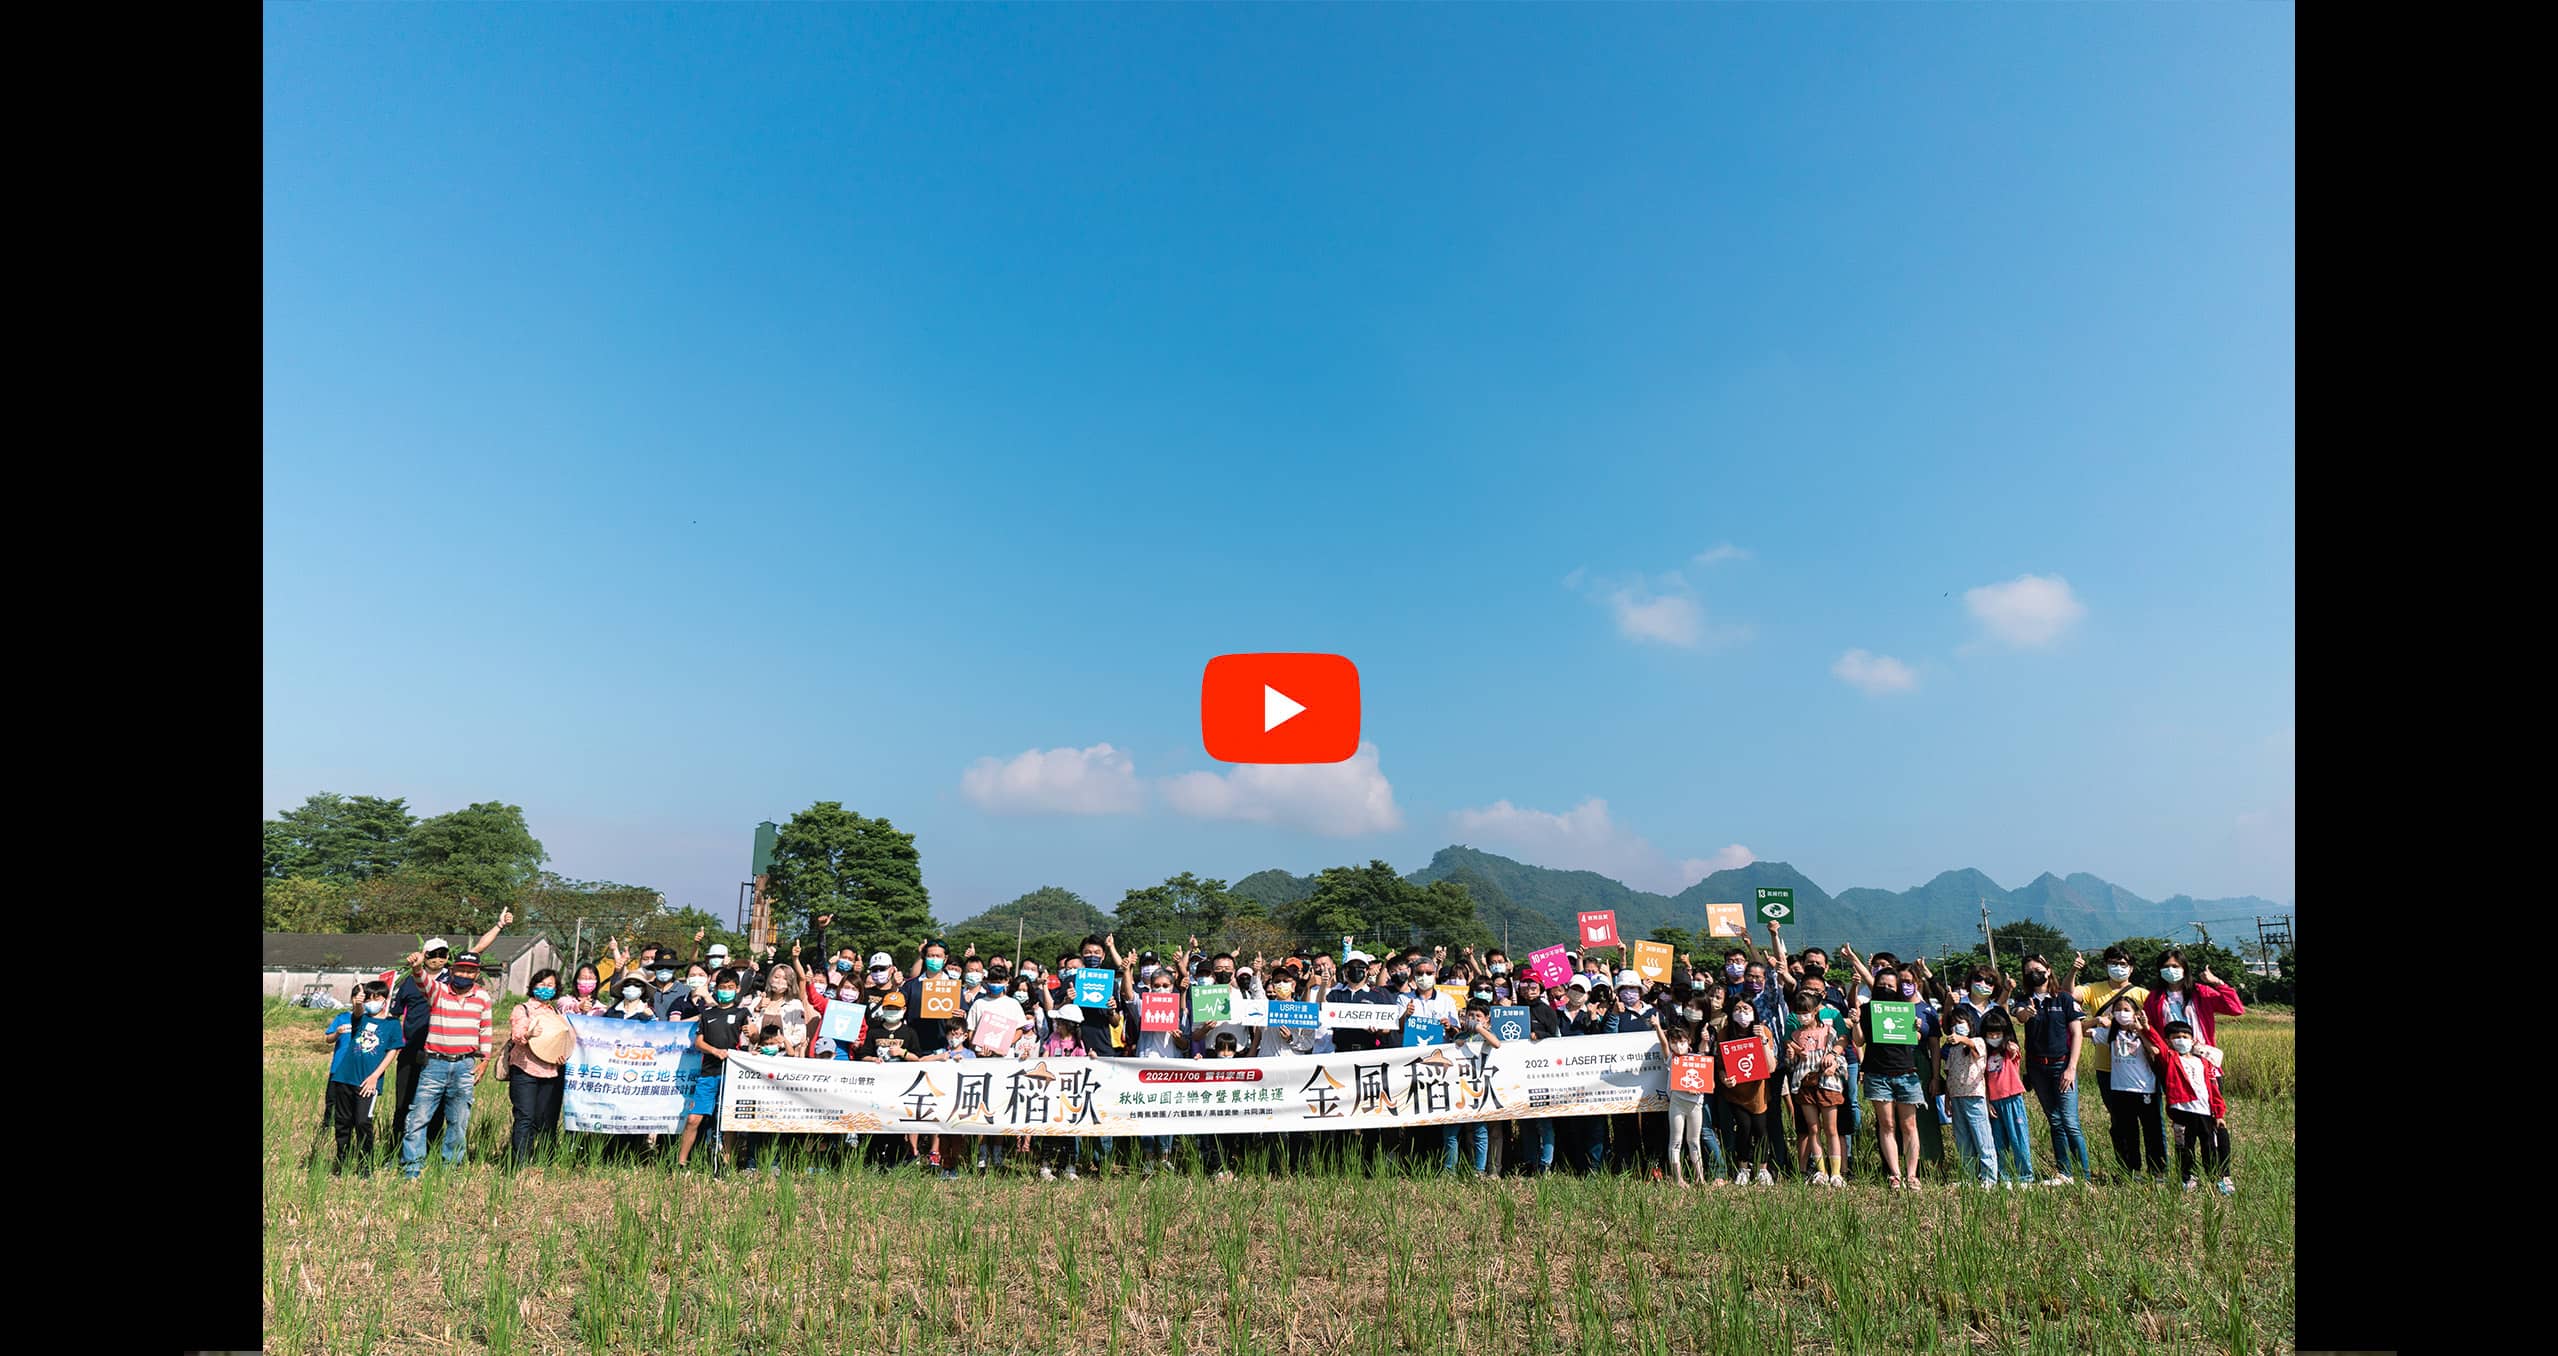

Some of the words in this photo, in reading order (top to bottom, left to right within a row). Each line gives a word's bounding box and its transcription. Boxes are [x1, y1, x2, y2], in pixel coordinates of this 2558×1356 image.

[1758, 889, 1766, 898] 13
[1581, 914, 1587, 923] 4
[1531, 954, 1541, 964] 10
[1494, 1009, 1501, 1018] 17
[1873, 1004, 1882, 1014] 15
[1338, 1010, 1373, 1020] LASER
[1375, 1011, 1395, 1021] TEK
[1408, 1017, 1416, 1028] 16
[1723, 1045, 1729, 1055] 5
[1525, 1059, 1549, 1069] 2022
[1565, 1055, 1597, 1066] LASER
[1599, 1054, 1617, 1064] TEK
[738, 1070, 762, 1080] 2022
[776, 1072, 809, 1081] LASER
[812, 1074, 832, 1083] TEK
[1145, 1072, 1200, 1081] 2022/11/06
[1299, 1052, 1505, 1119] 金風稻歌
[898, 1066, 1102, 1125] 金風稻歌
